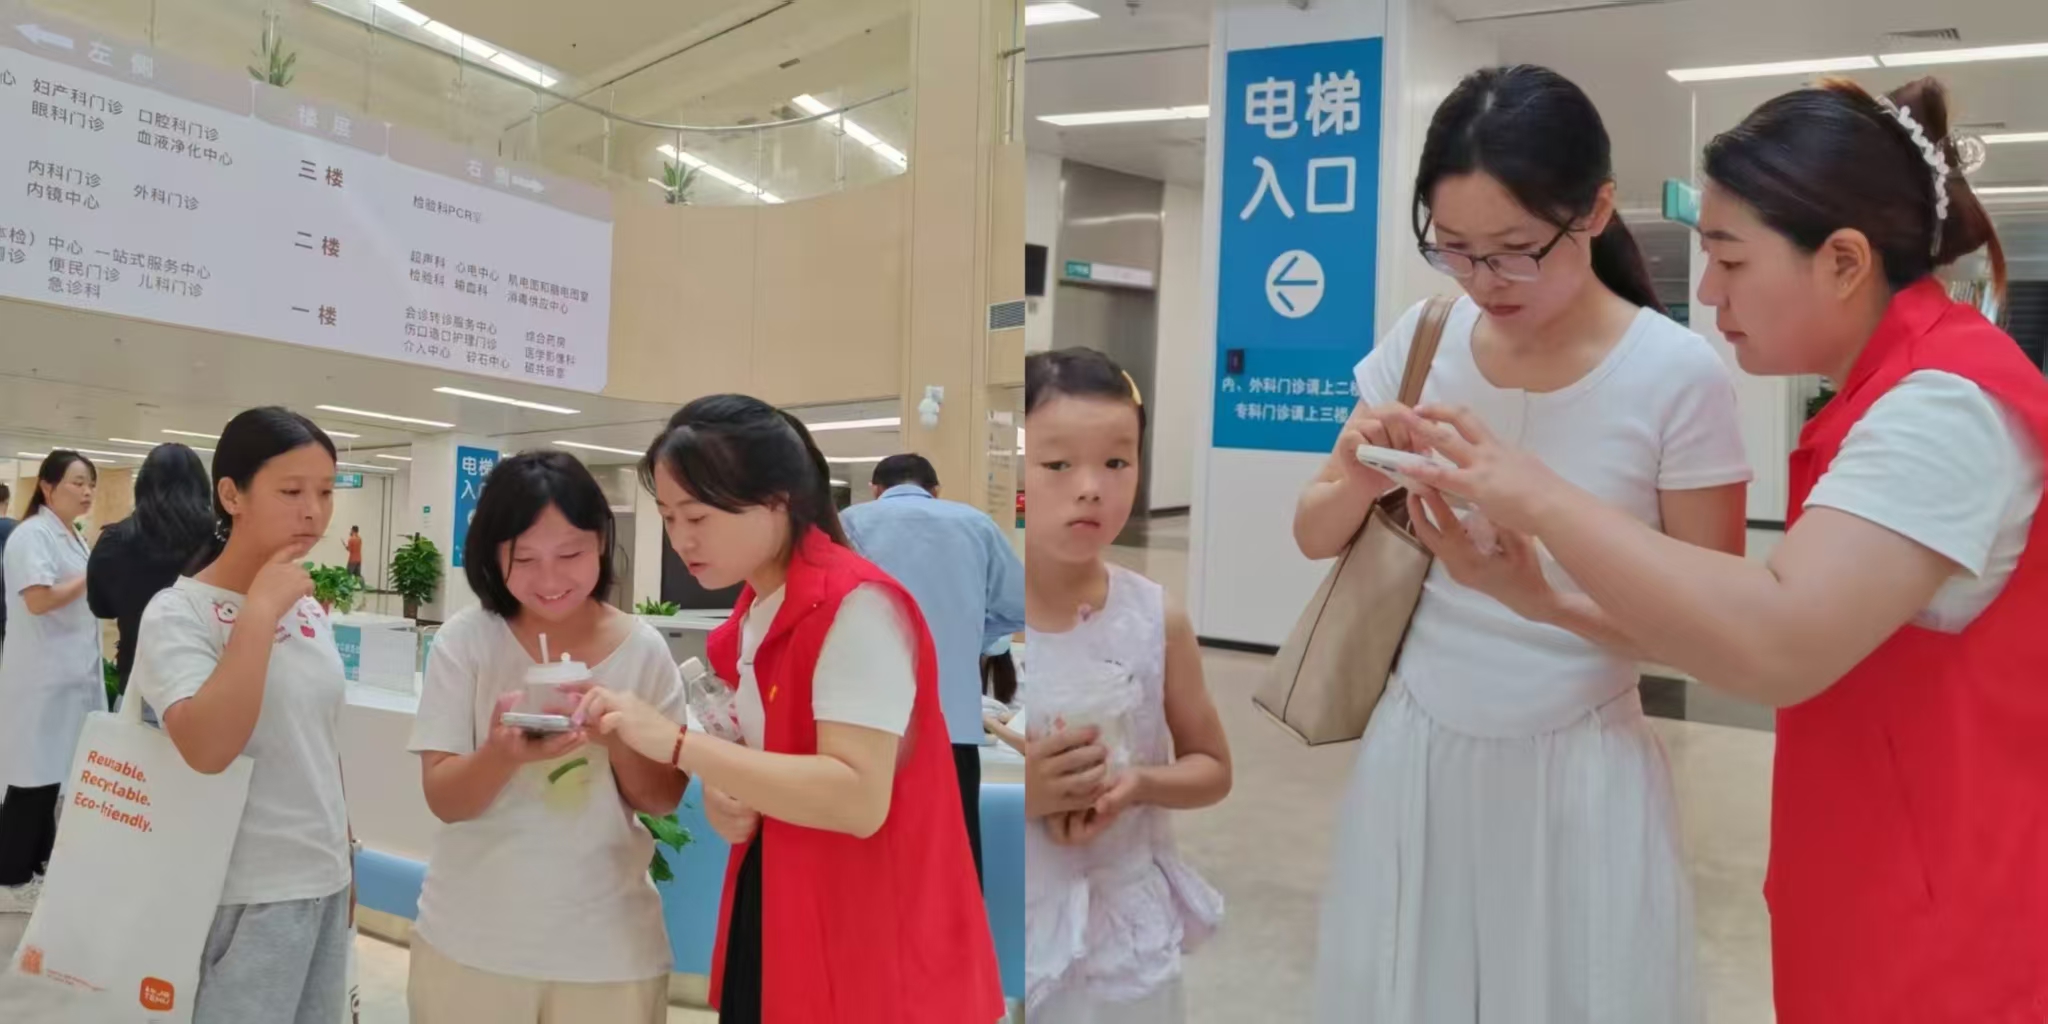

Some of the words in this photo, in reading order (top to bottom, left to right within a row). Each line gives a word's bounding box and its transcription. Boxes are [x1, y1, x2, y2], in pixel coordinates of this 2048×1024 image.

[33, 78, 123, 115] 妇产科门诊
[139, 109, 219, 142] 口腔科门诊
[1245, 70, 1361, 139] 电梯
[32, 101, 105, 132] 眼科门诊
[137, 129, 233, 166] 血液净化中心
[28, 160, 101, 188] 内科门诊
[133, 184, 199, 211] 外科门诊
[298, 159, 344, 188] 三楼
[27, 182, 100, 210] 内镜中心
[1239, 156, 1356, 221] 入口
[294, 231, 340, 257] 二楼
[49, 257, 120, 283] 便民门诊
[139, 273, 203, 298] 儿科门诊
[95, 248, 211, 280] 一站式服务中心
[409, 268, 445, 286] 检验科
[410, 249, 446, 269] 超声科
[456, 261, 500, 282] 心电中心
[48, 277, 101, 299] 急诊科
[292, 304, 337, 326] 一楼
[405, 306, 497, 335] 会诊转诊服务中心
[403, 340, 450, 359] 介入中心
[1234, 402, 1349, 424] 专科门诊请上三楼
[462, 456, 495, 477] 电梯
